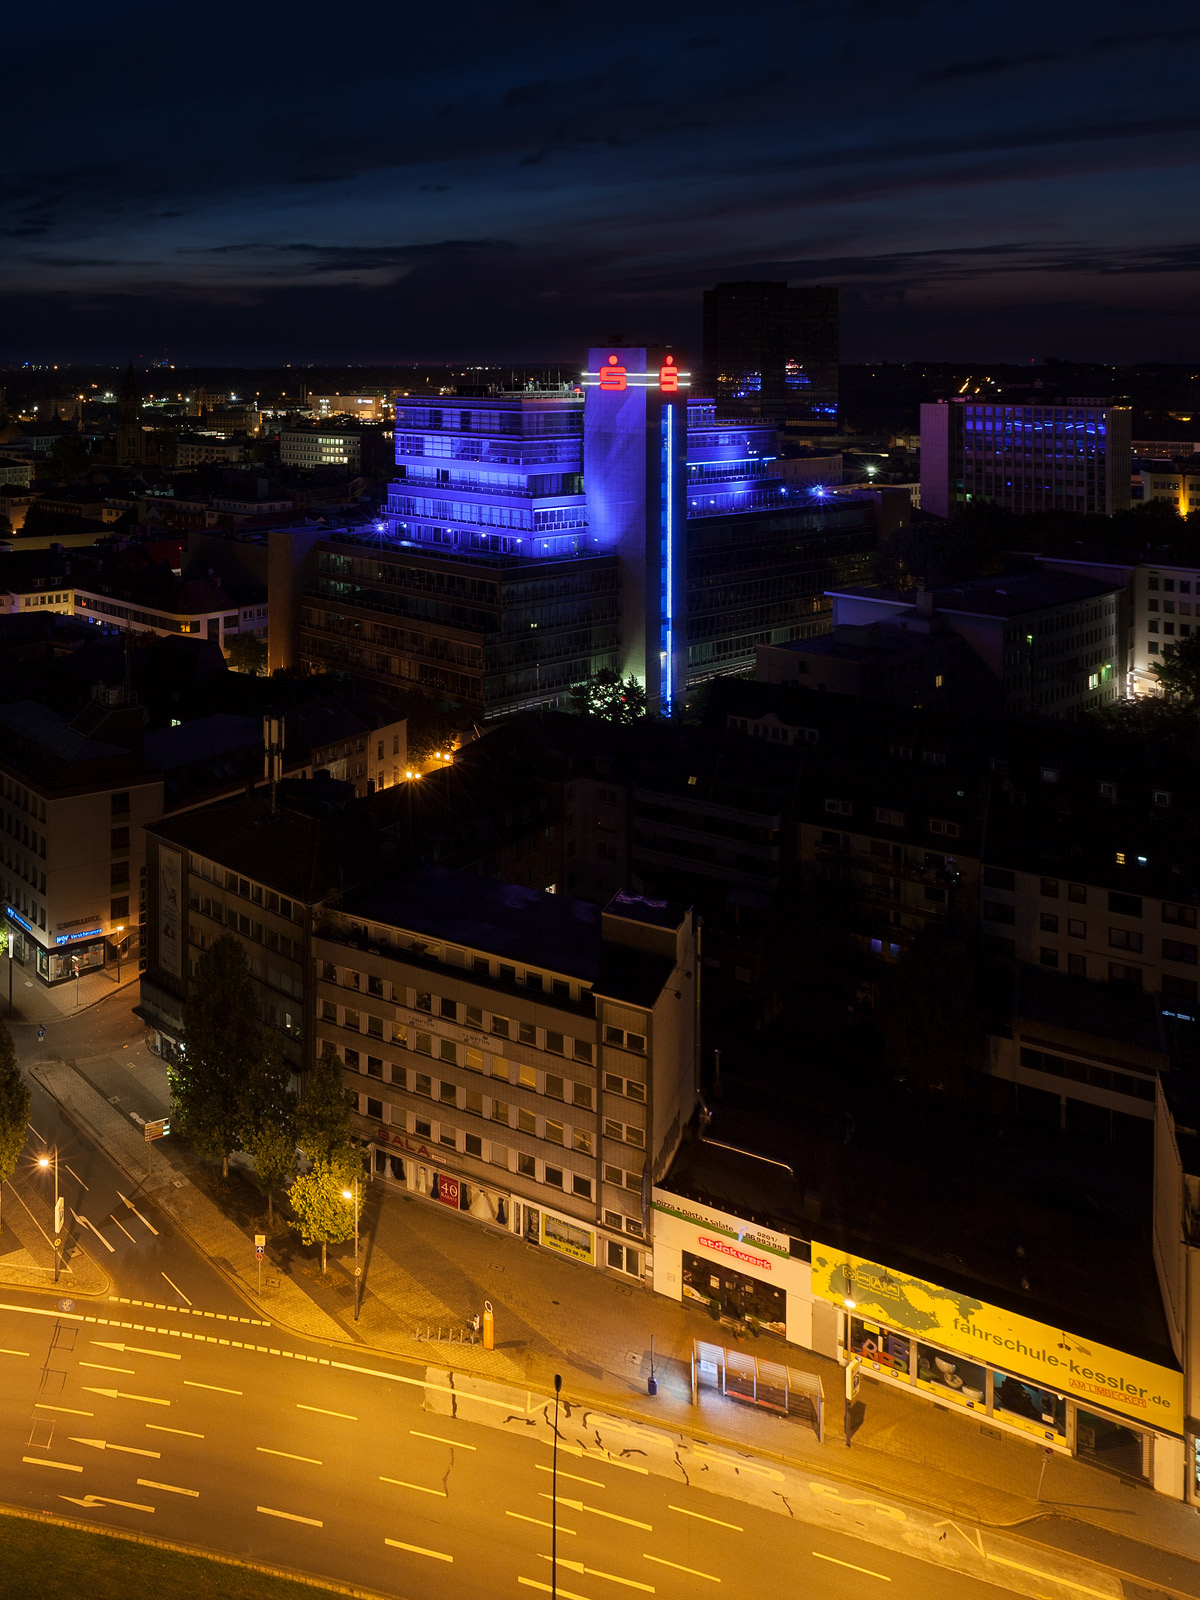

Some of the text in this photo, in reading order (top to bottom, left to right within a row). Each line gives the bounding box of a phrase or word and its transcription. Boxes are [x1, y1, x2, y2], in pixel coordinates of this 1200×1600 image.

[656, 1199, 734, 1232] pizza pasta salate
[952, 1317, 1171, 1409] fahrschule-kessler.de
